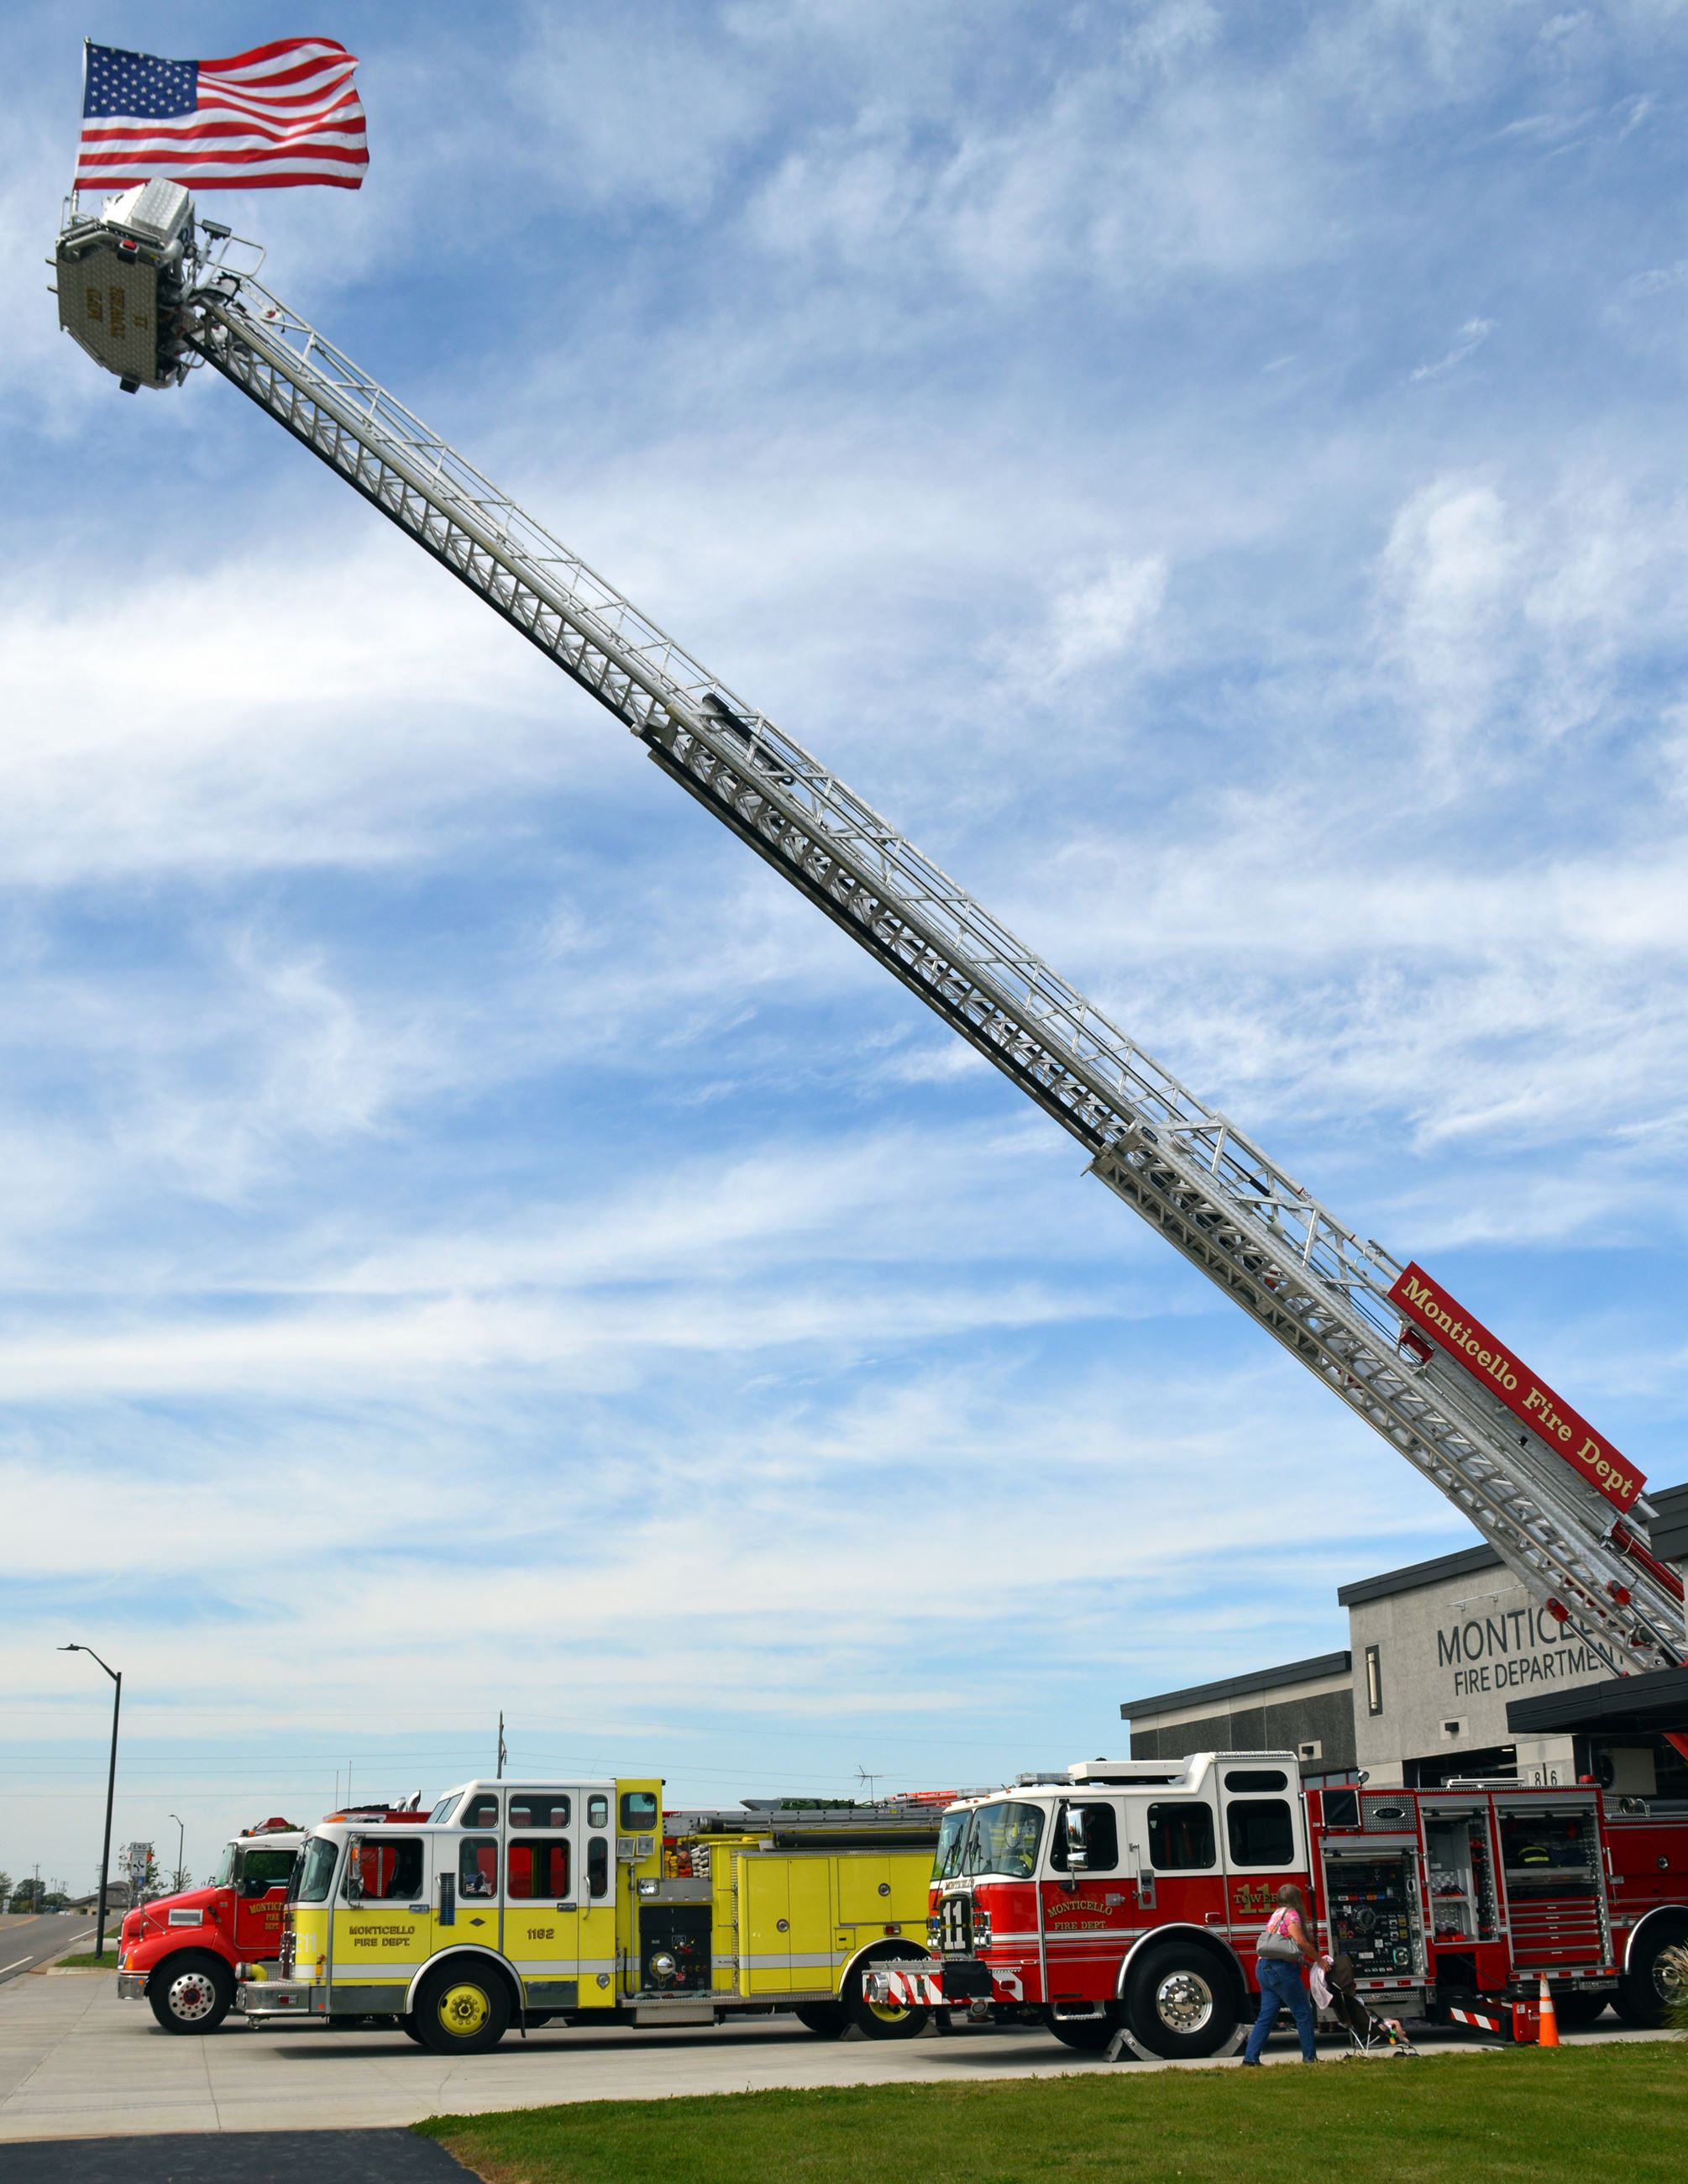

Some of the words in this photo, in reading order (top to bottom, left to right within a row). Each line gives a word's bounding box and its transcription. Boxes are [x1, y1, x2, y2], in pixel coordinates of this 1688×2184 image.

[1401, 1275, 1518, 1391] Monticello
[1523, 1387, 1572, 1442] Fire
[1576, 1437, 1633, 1499] Dept
[1454, 1666, 1491, 1696] FIRE
[1046, 1900, 1113, 1918] MONTICELLO
[1236, 1883, 1276, 1914] 11
[349, 1925, 415, 1935] MONTICELLO
[943, 1901, 966, 1950] 11
[1054, 1922, 1077, 1930] FIRE
[354, 1938, 377, 1946] FIRE
[382, 1937, 410, 1946] DEPT.
